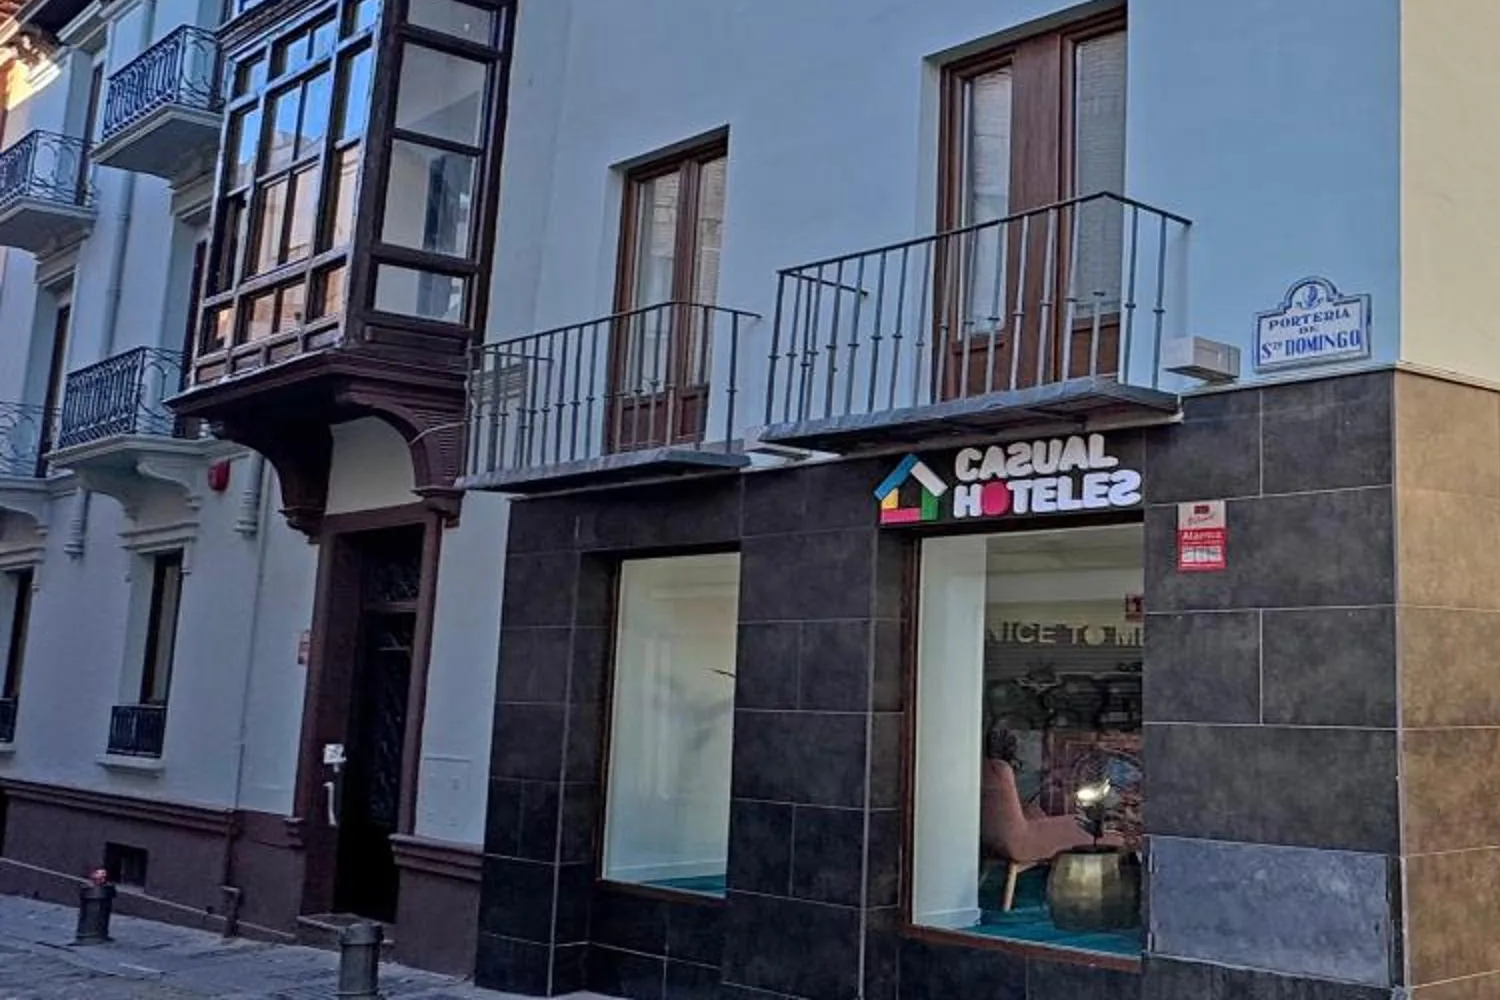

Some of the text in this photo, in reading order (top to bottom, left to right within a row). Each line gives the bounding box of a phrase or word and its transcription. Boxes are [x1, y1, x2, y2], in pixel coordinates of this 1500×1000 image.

[1286, 330, 1360, 356] DOMINGO
[955, 434, 1118, 481] CASUAL
[953, 470, 1142, 519] HOTELES
[1067, 625, 1105, 646] TO
